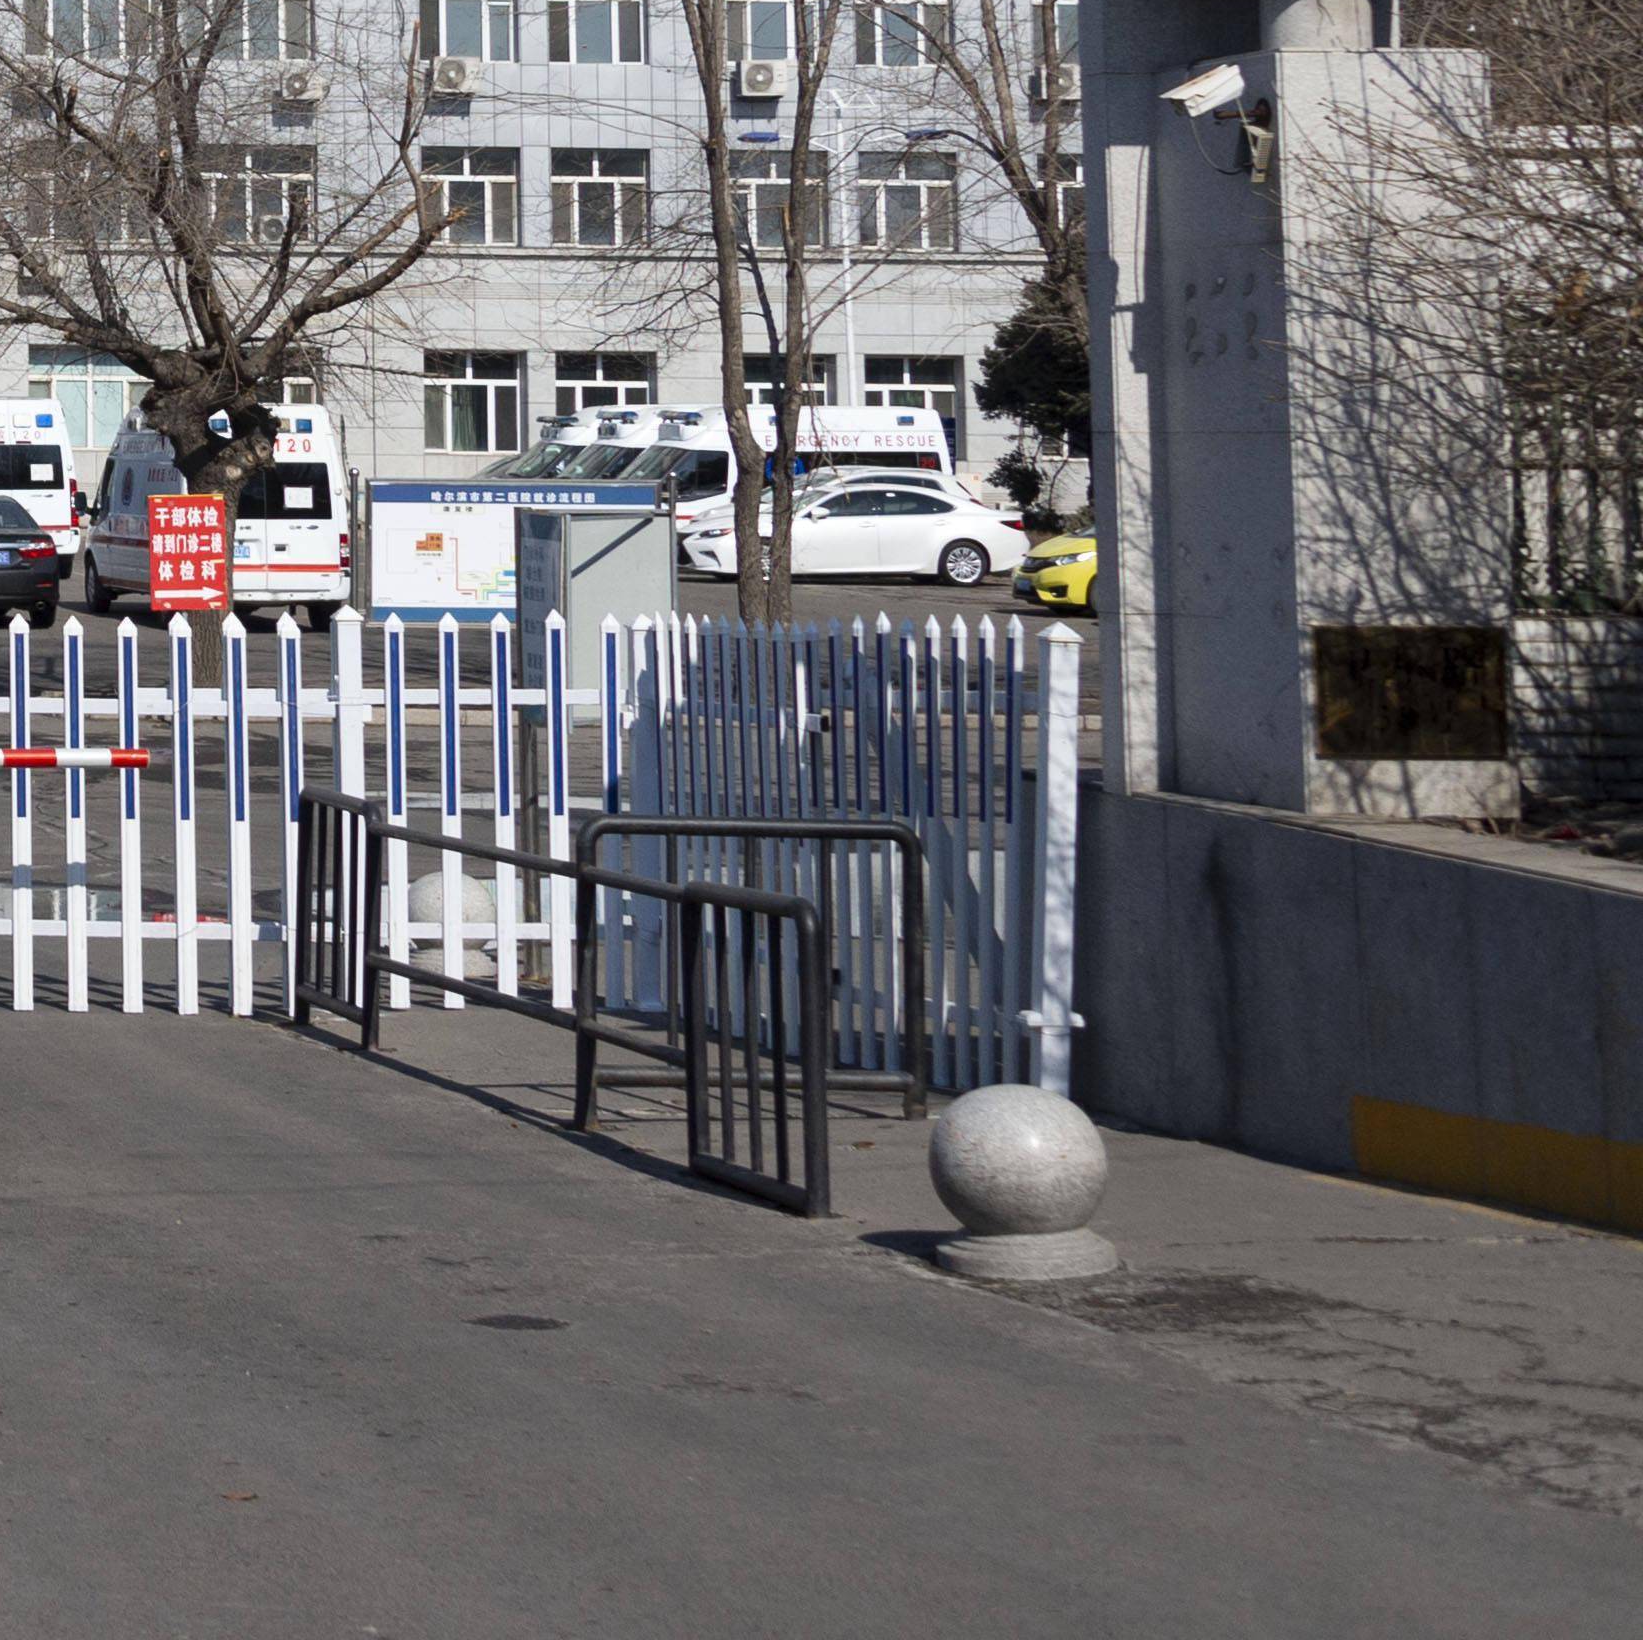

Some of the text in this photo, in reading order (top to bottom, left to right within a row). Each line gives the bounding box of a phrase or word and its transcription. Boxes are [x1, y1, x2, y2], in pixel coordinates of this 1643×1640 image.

[765, 434, 936, 447] ERGENCY RESCUE
[155, 506, 219, 528] 干部体检
[152, 532, 223, 555] 请到门诊二楼
[158, 560, 217, 581] 体检科
